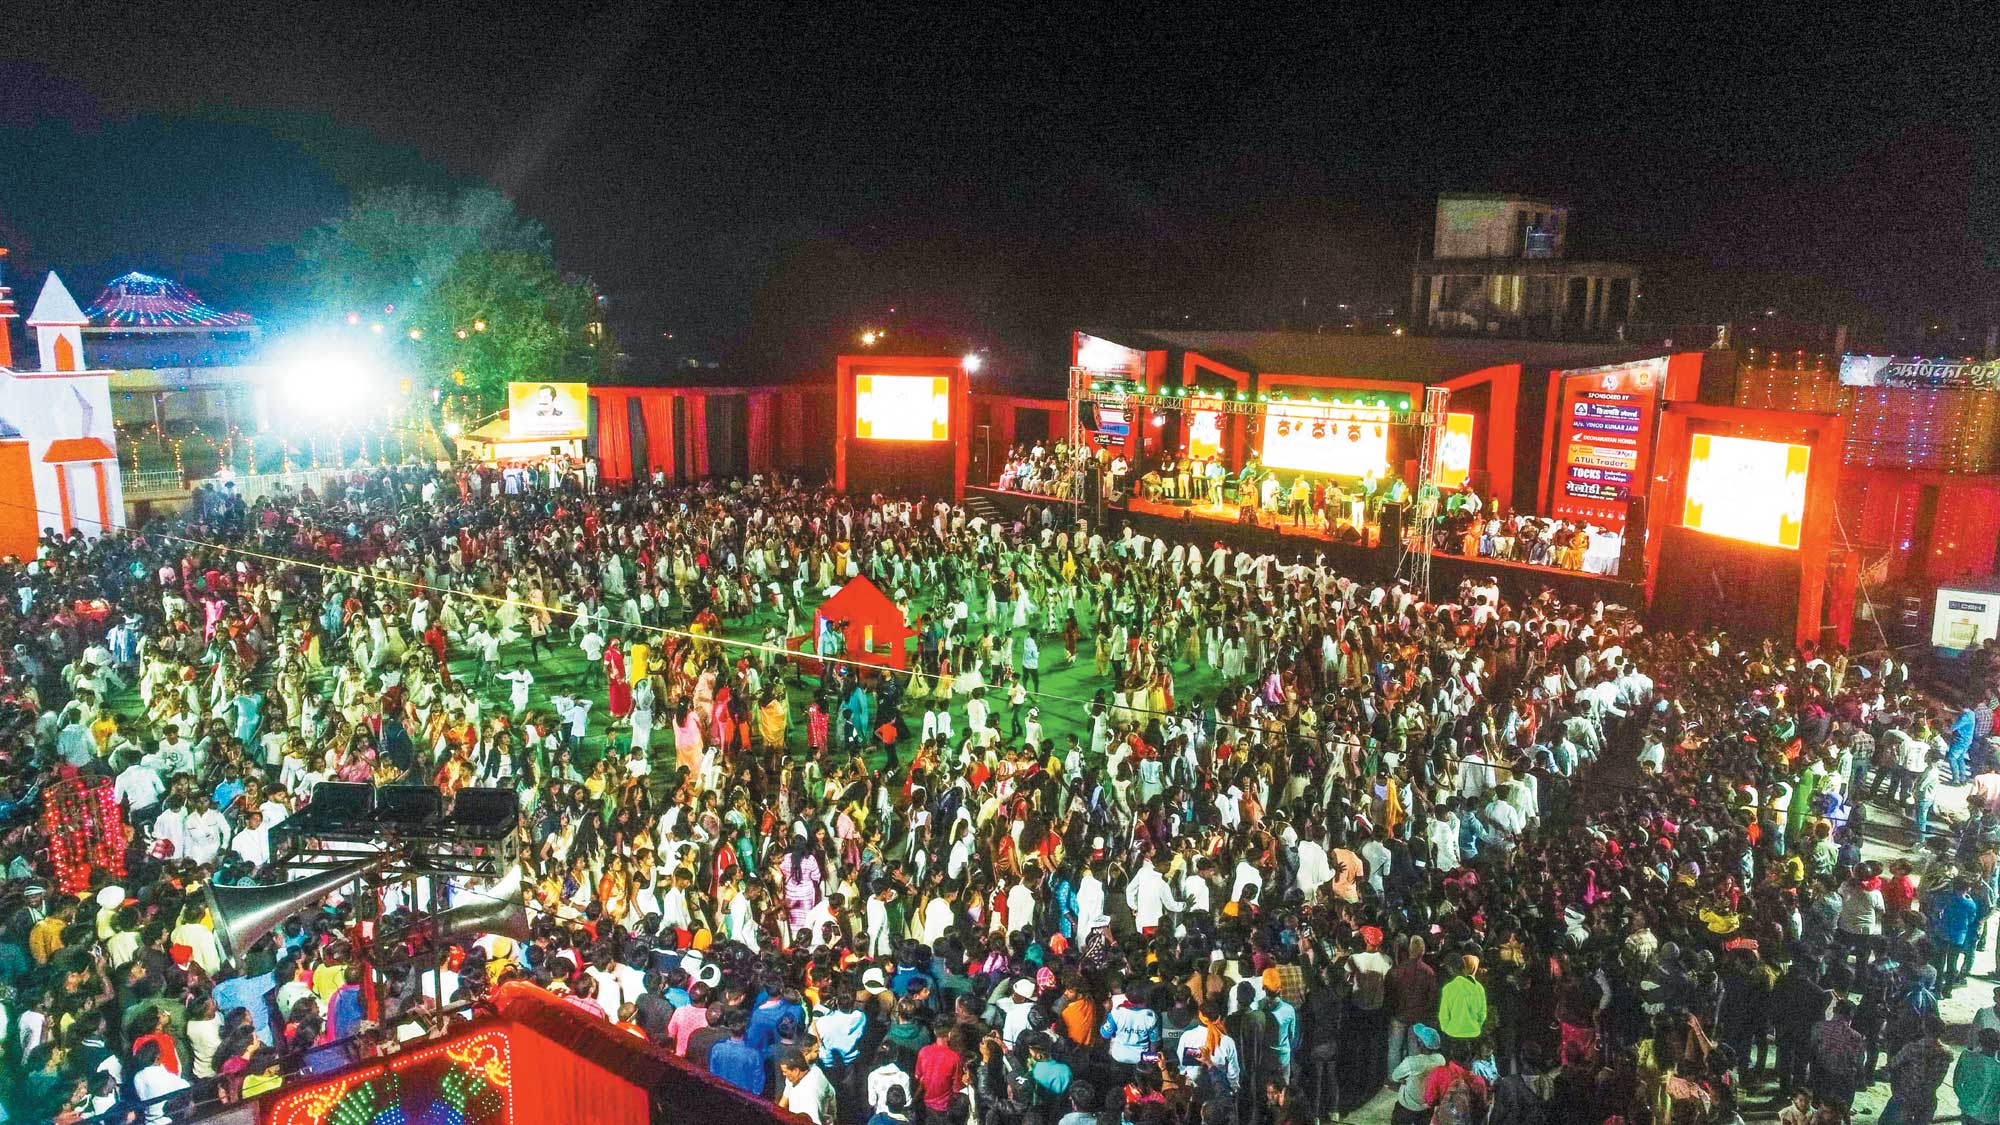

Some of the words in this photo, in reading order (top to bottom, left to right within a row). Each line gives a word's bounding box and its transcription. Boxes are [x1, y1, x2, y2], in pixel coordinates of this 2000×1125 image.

[1588, 392, 1621, 400] SPONSORED
[1586, 422, 1604, 430] VINOD
[1618, 437, 1637, 445] HONDA
[1574, 456, 1594, 464] ATUL
[1597, 458, 1628, 468] Traders
[1572, 467, 1601, 480] TOCKS
